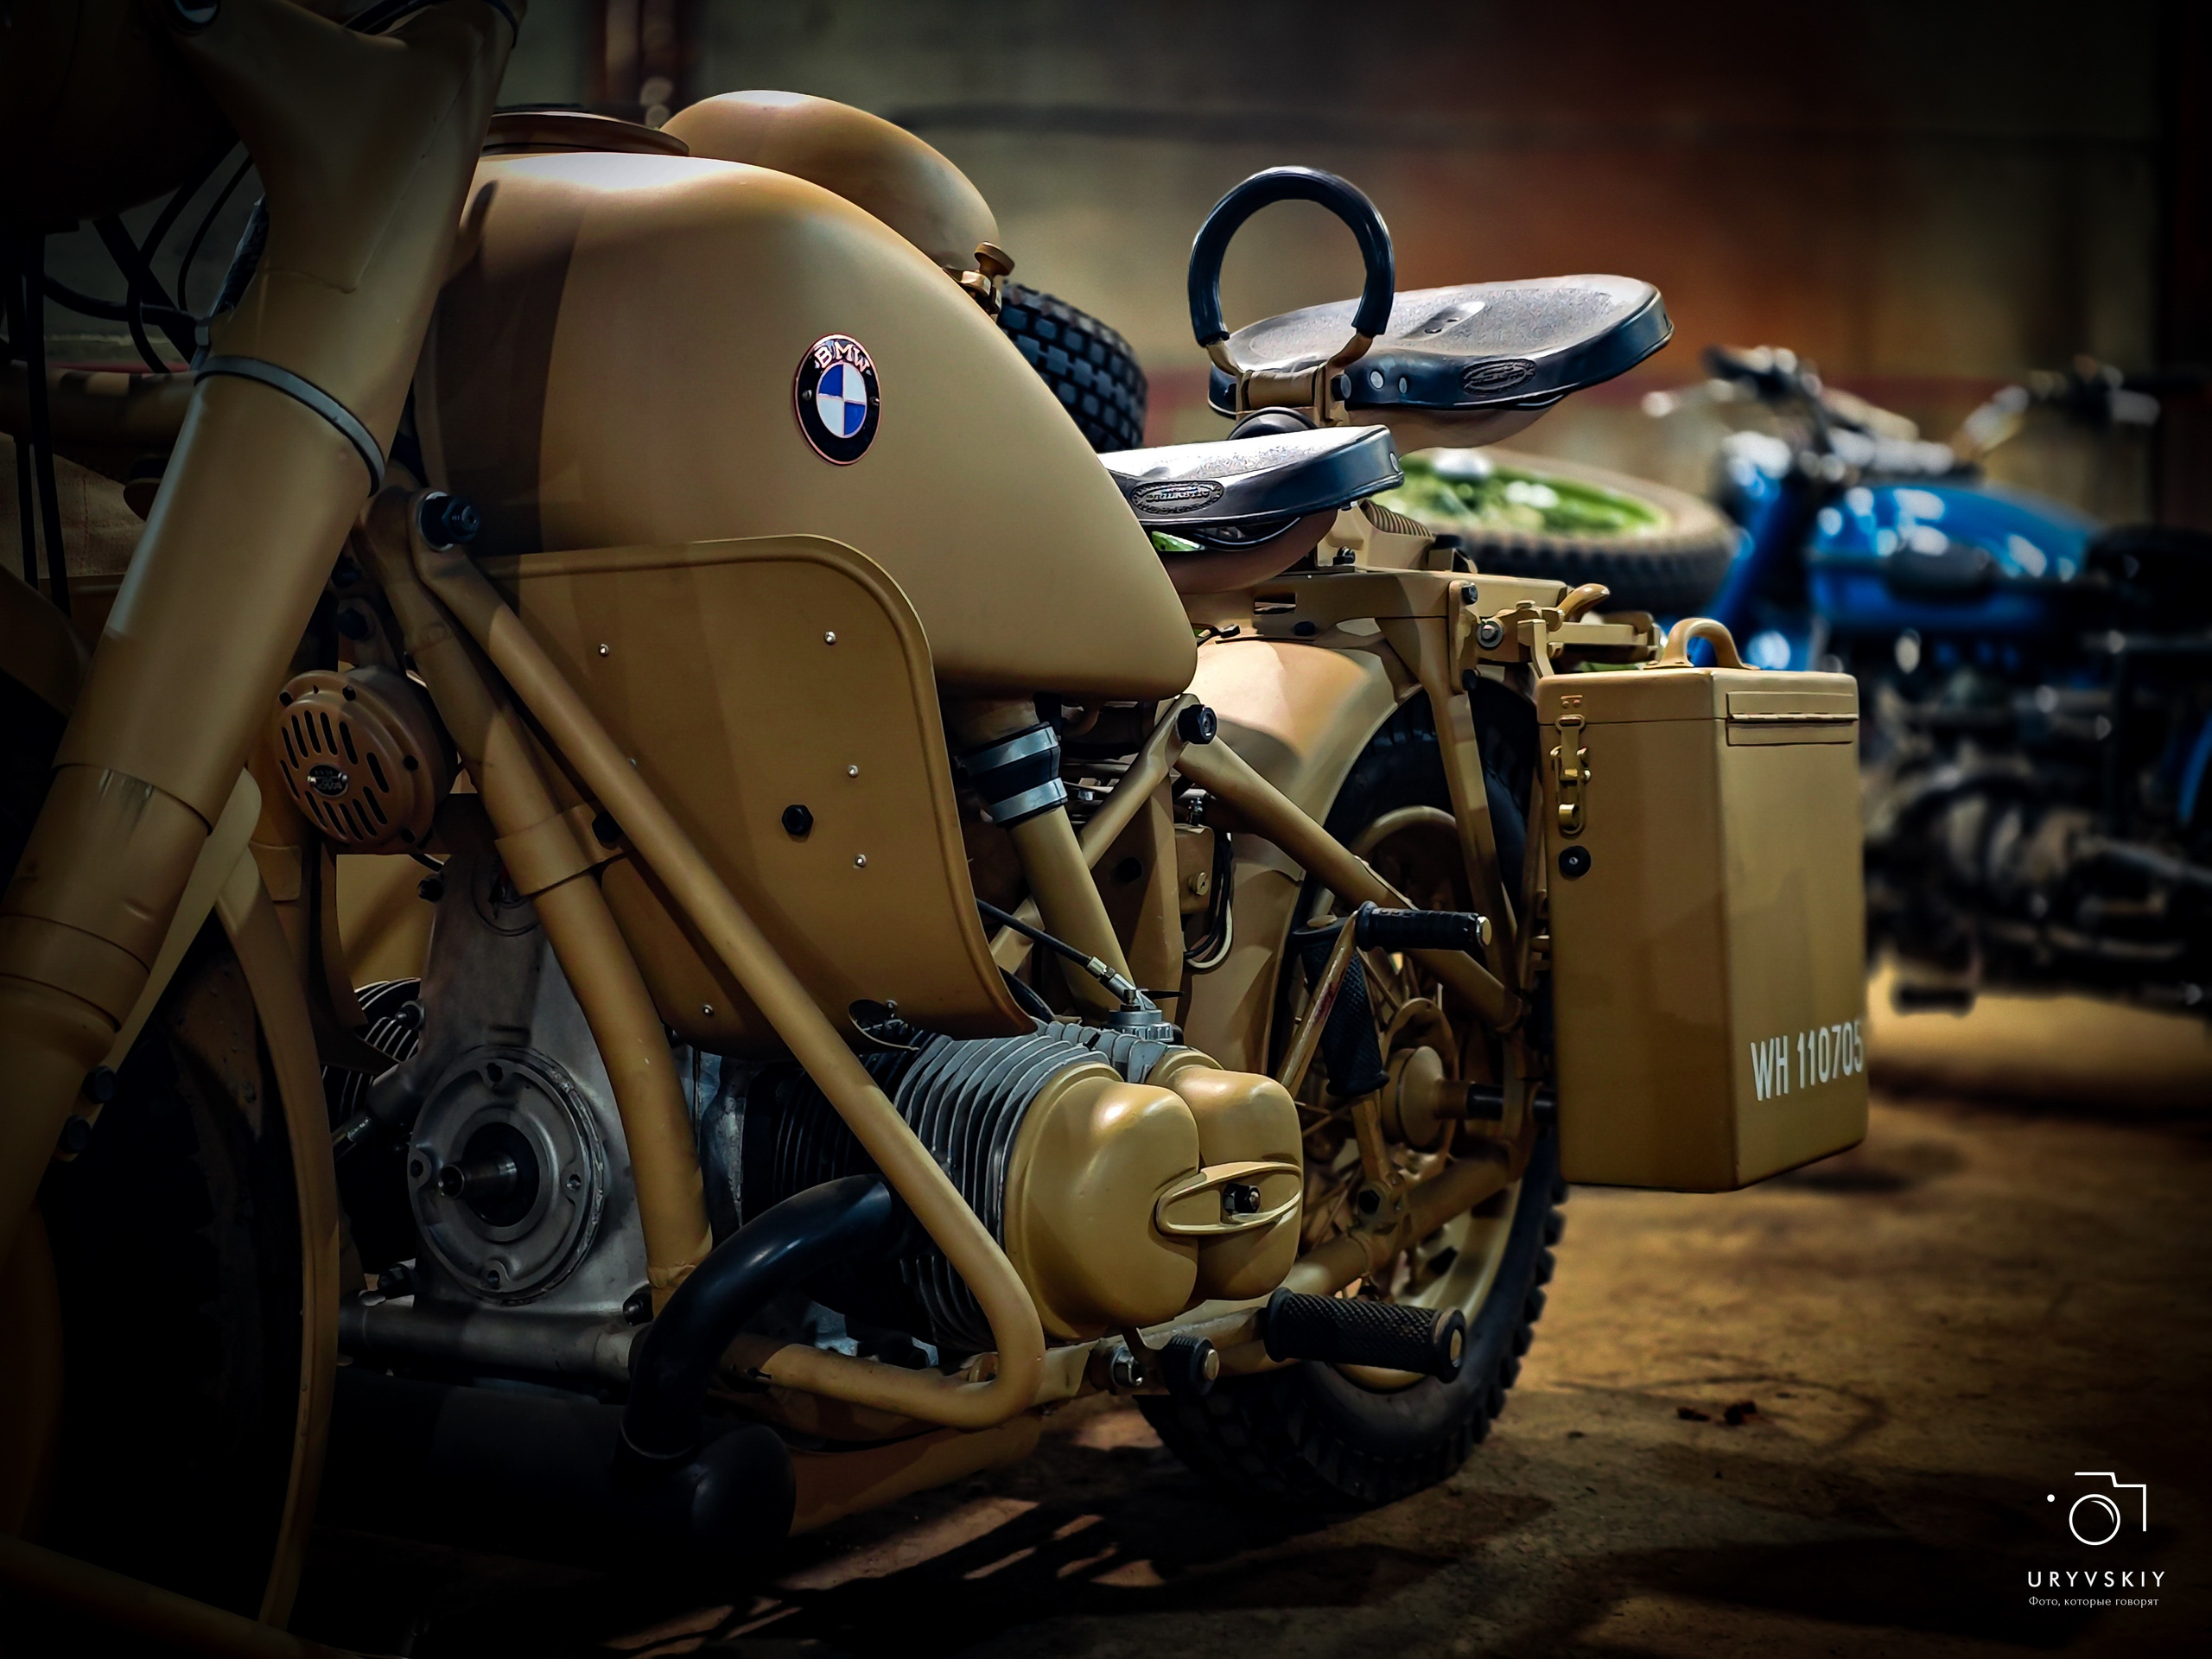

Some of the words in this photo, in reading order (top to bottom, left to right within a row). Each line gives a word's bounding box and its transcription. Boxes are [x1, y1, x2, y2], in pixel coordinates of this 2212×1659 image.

[814, 341, 870, 372] BMW
[1751, 1035, 1789, 1102] WH
[1797, 1020, 1864, 1089] 110705
